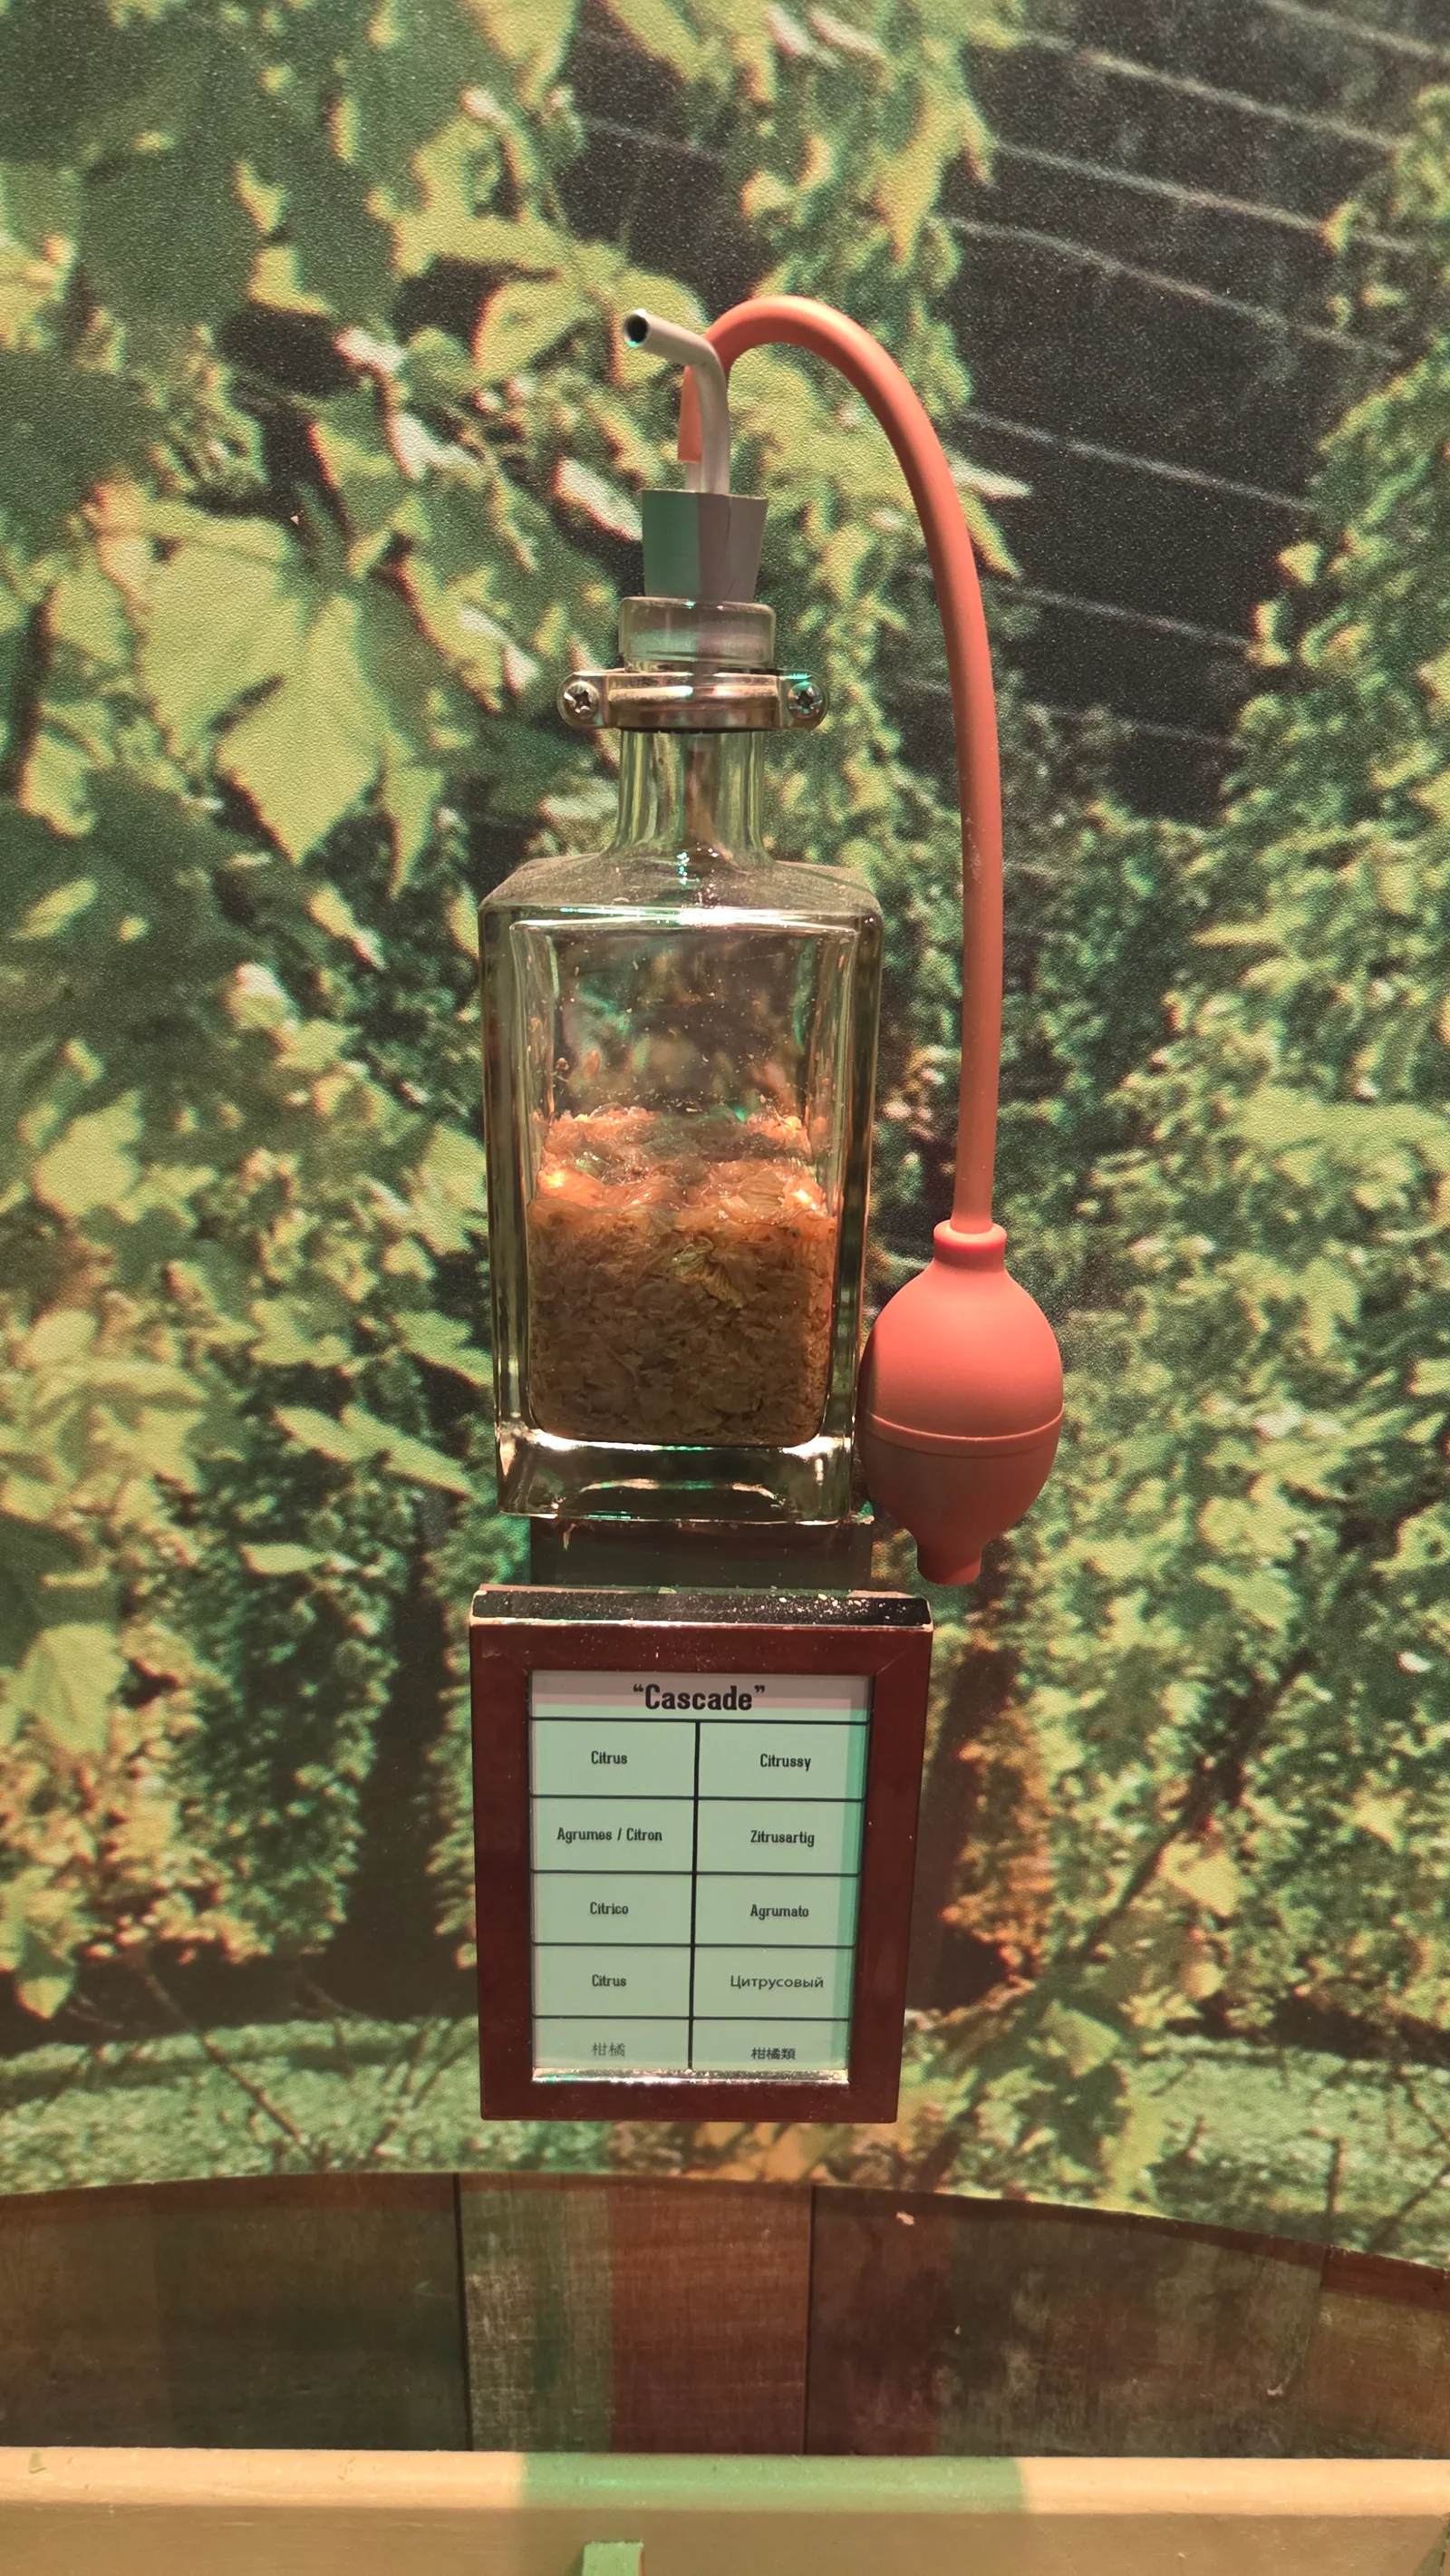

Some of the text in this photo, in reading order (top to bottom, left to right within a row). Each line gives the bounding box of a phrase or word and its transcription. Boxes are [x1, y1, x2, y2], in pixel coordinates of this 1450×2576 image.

[590, 1749, 628, 1766] Citrus
[759, 1752, 812, 1773] Citrussy
[556, 1826, 613, 1845] Agrumes
[625, 1826, 663, 1842] Citron
[749, 1829, 816, 1848] Zitrusartig
[749, 1903, 809, 1922] Agrumato
[591, 1973, 627, 1988] Citrus
[730, 1974, 824, 1990] Цитрусовый
